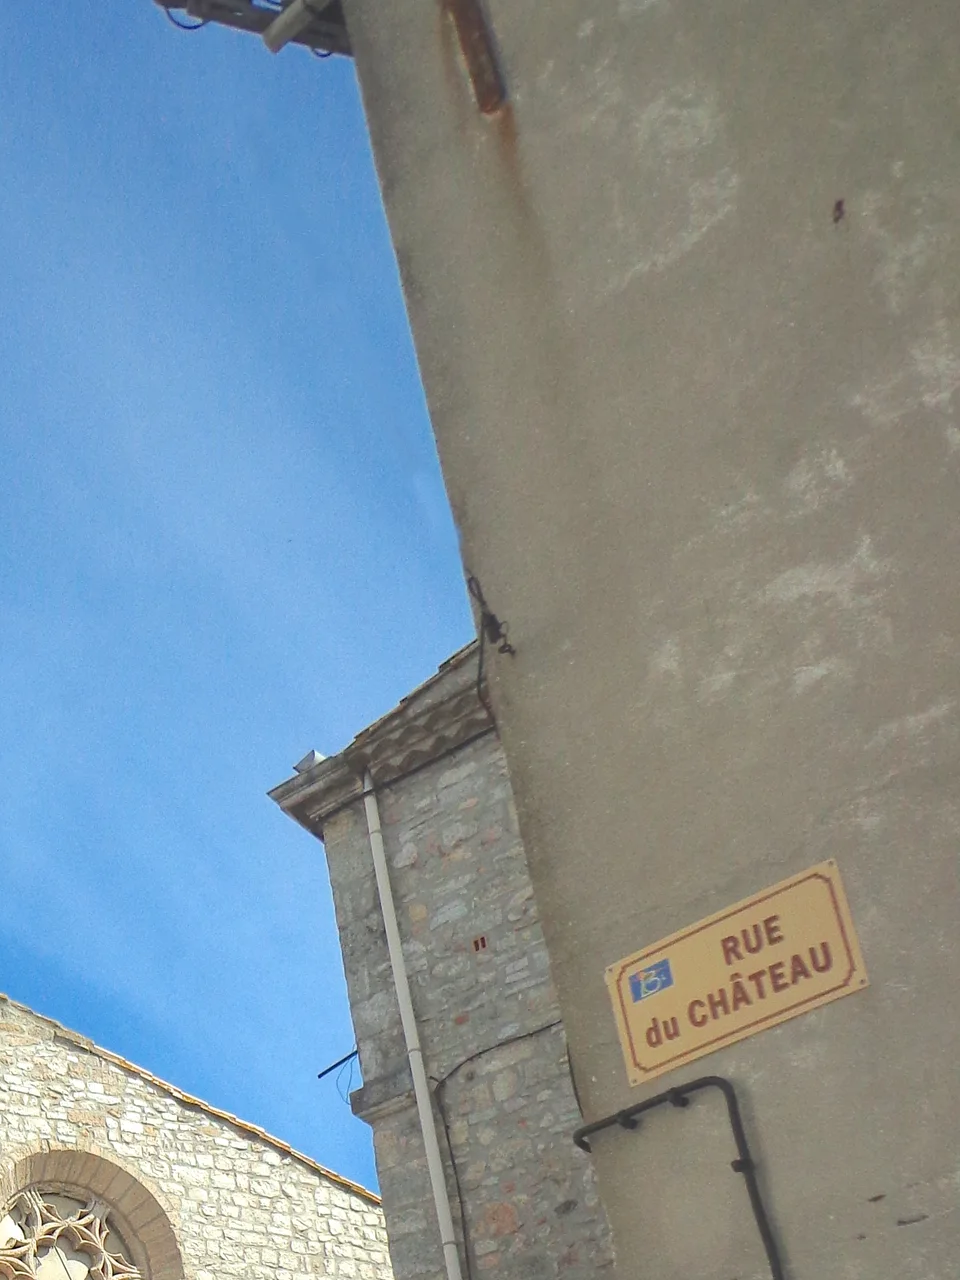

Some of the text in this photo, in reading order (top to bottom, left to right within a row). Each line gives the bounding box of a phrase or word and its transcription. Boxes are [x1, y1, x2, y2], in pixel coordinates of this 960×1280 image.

[720, 914, 784, 966] RUE
[645, 941, 833, 1048] du CHÂTEAU
